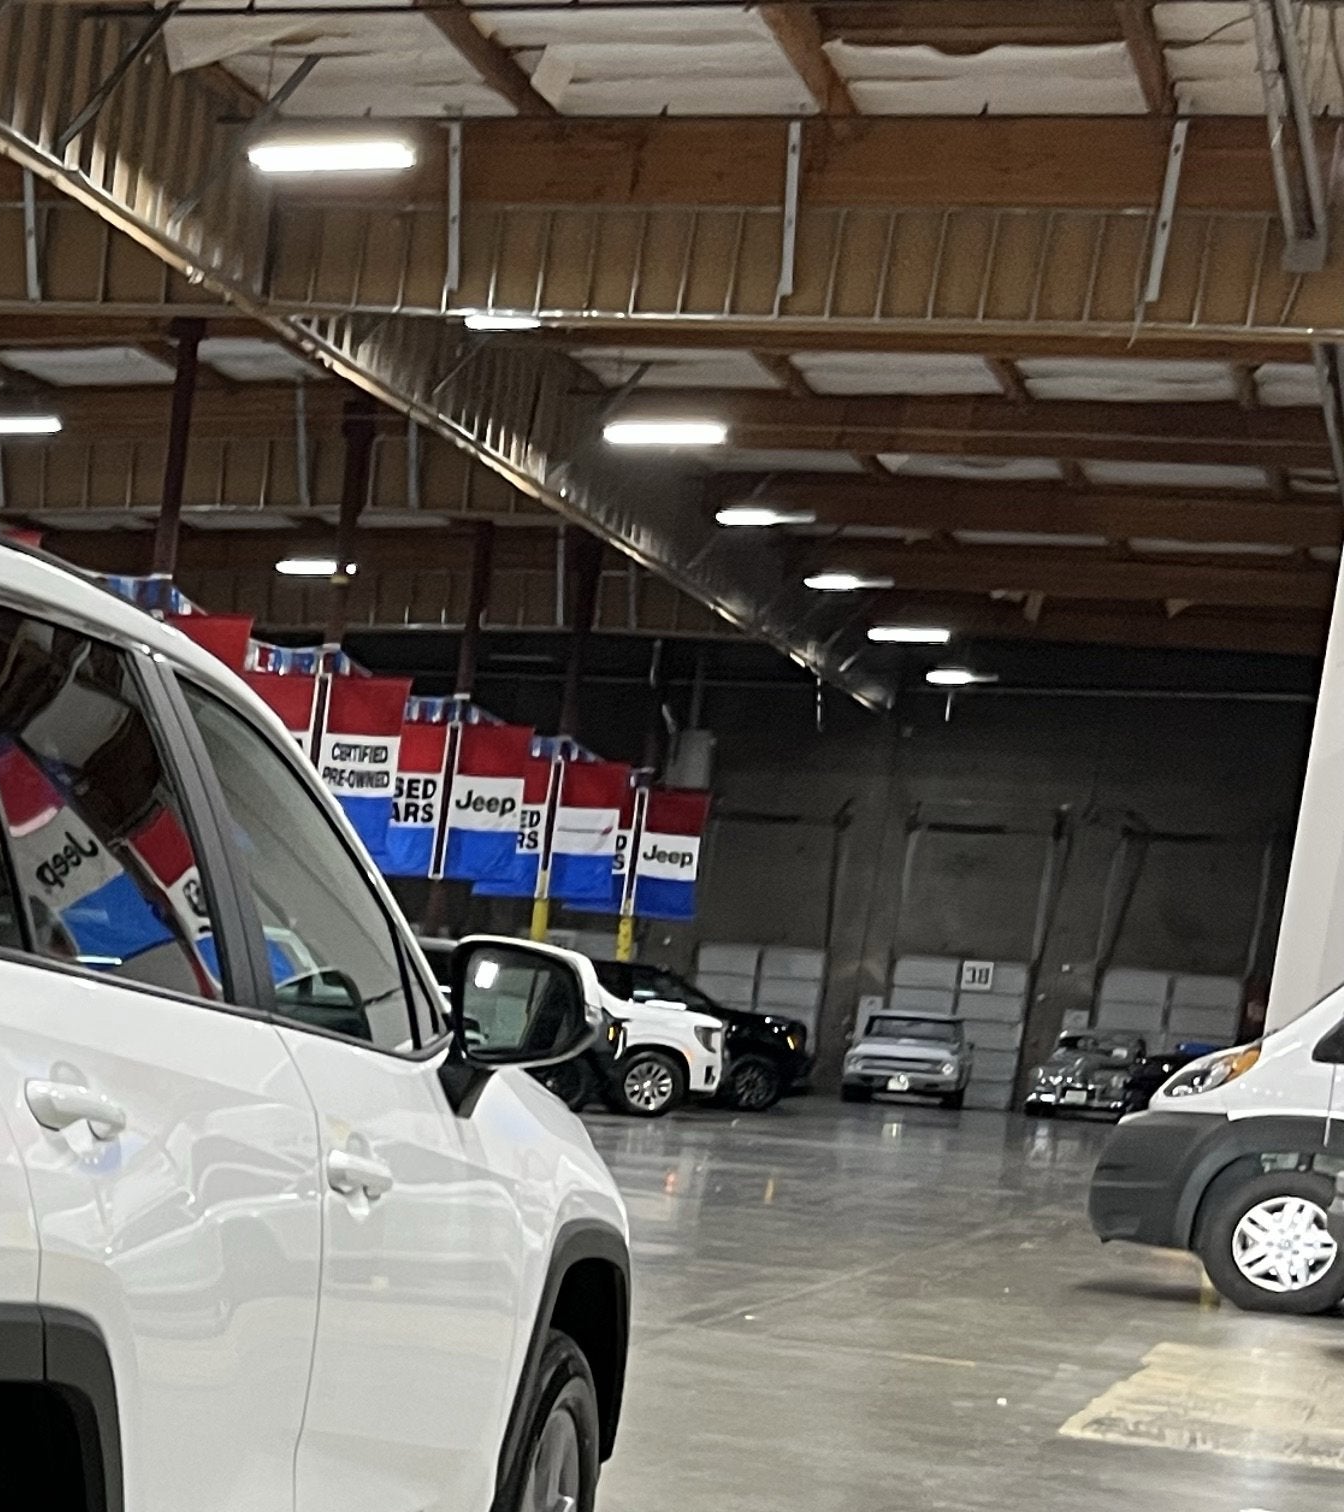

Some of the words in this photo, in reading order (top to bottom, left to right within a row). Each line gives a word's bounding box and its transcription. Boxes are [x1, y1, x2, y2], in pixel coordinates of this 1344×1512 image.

[332, 743, 388, 764] CERTIFIED
[322, 766, 390, 789] PRE-OWNED
[393, 777, 437, 799] SED
[455, 789, 517, 818] Jeep
[643, 845, 694, 869] Jeep
